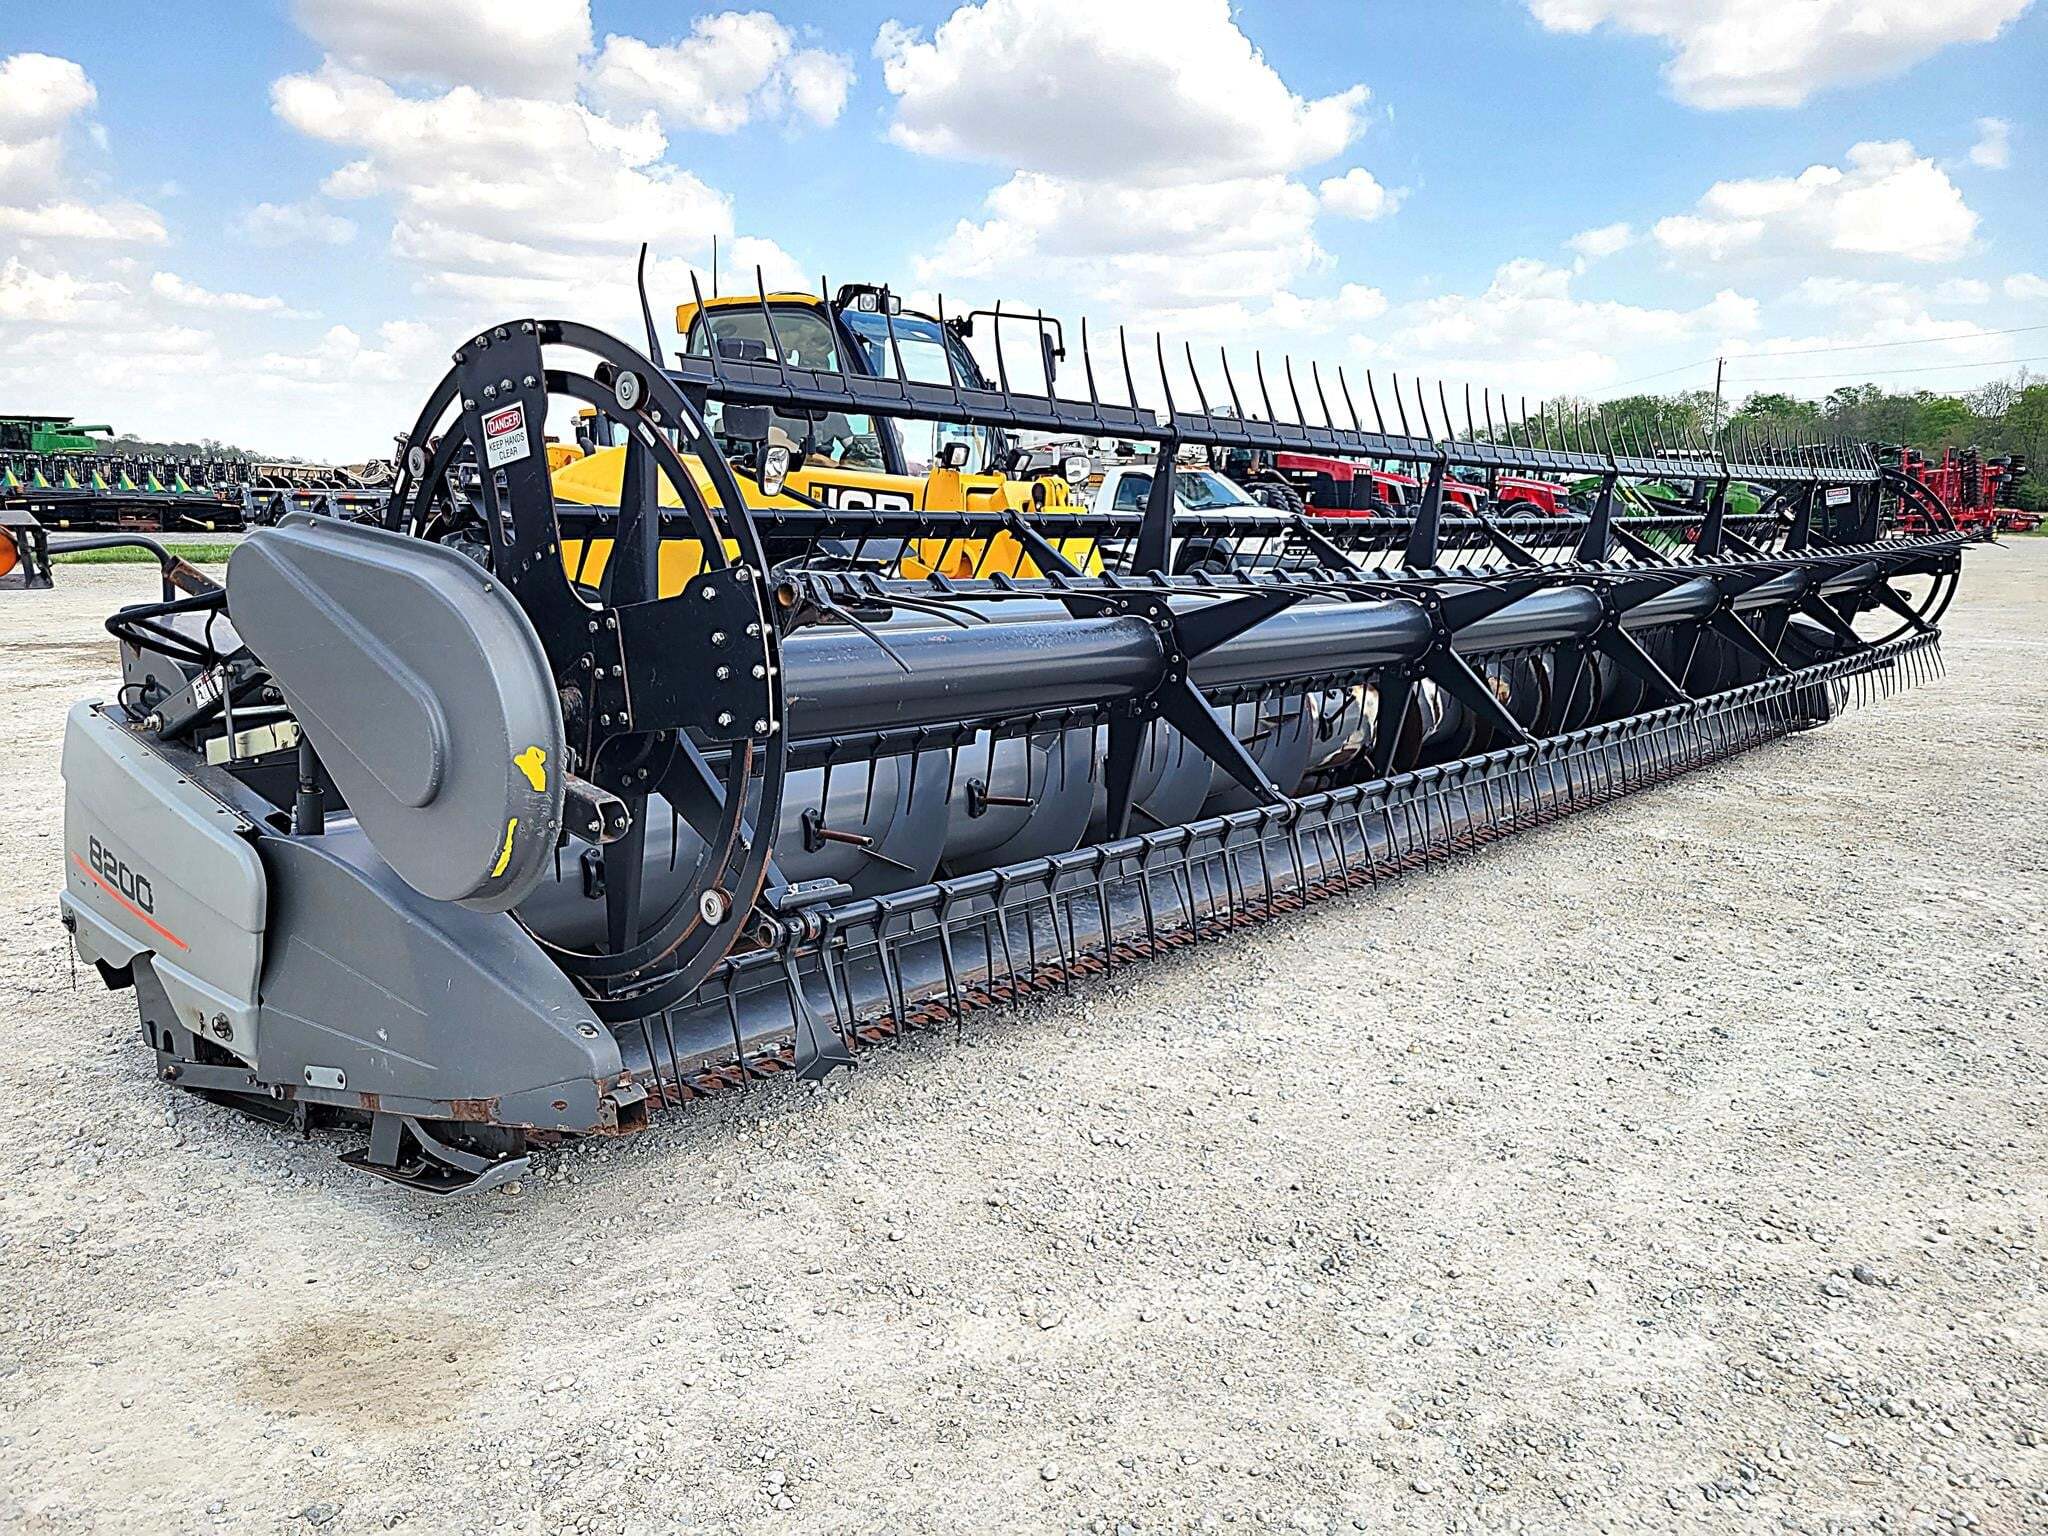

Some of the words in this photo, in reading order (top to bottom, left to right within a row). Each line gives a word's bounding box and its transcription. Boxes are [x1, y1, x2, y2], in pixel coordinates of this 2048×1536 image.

[489, 413, 519, 433] DANGER
[488, 439, 504, 452] KEEP
[505, 432, 525, 446] HANDS
[499, 446, 518, 460] CLEAR
[90, 834, 154, 914] 8200
